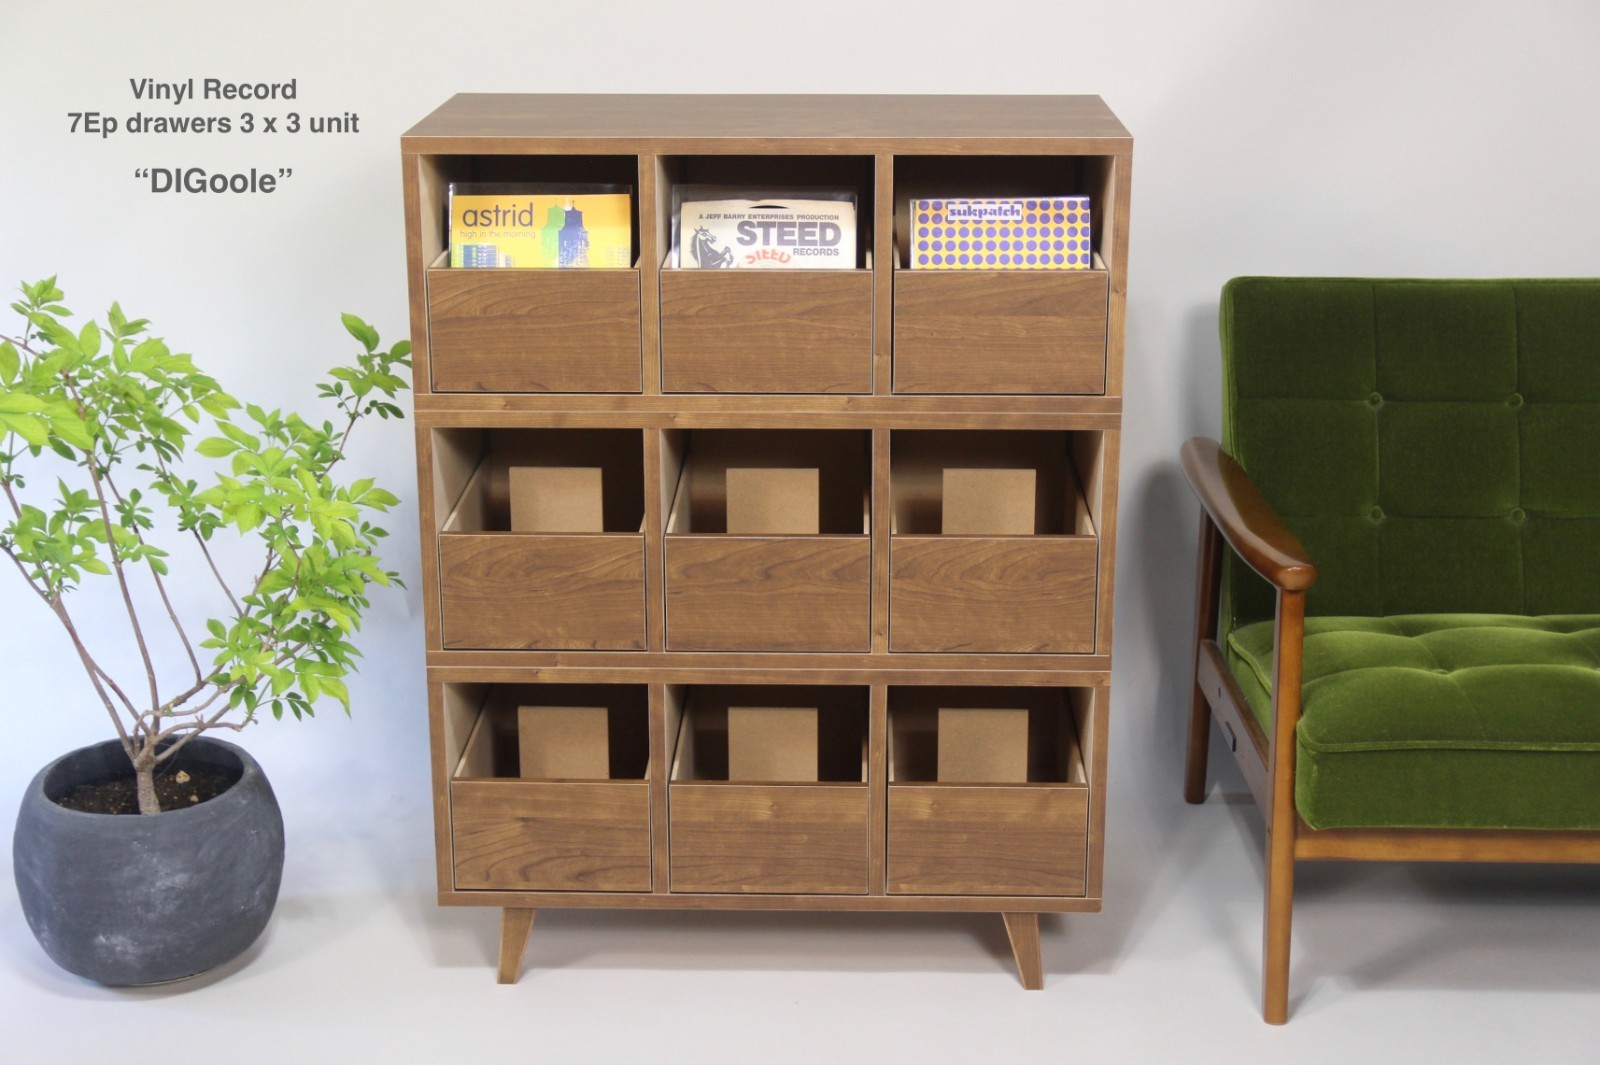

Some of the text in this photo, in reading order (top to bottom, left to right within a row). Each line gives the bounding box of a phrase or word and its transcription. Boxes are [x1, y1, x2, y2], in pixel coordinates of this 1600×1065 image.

[462, 202, 533, 227] astrid
[949, 205, 1020, 218] sukpatch
[460, 230, 477, 239] high
[489, 230, 501, 238] the
[503, 230, 536, 239] morning
[736, 220, 842, 247] STEED
[793, 248, 839, 256] RECORDS
